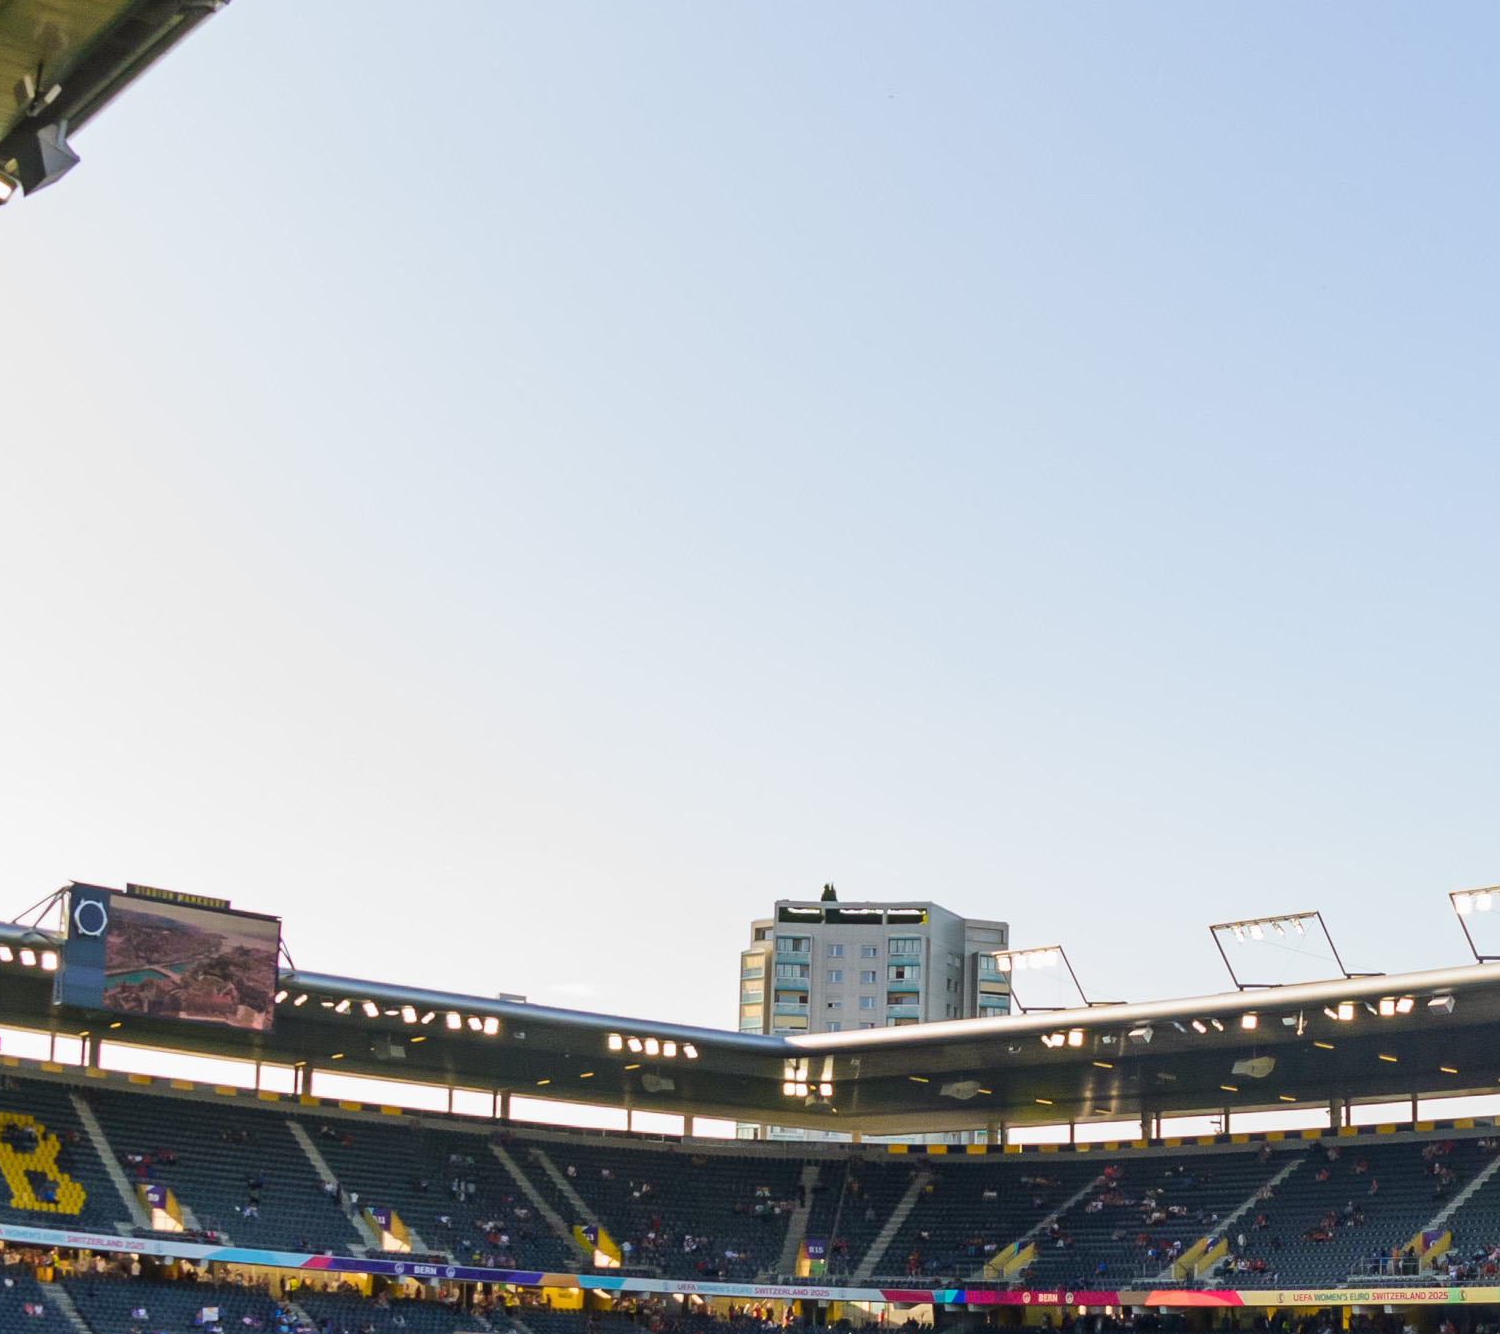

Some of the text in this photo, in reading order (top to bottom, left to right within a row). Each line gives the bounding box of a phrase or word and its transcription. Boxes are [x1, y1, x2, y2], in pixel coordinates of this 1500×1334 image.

[67, 1235, 123, 1249] SWITZERLAND
[126, 1240, 146, 1250] 2025
[414, 1265, 437, 1275] BERN
[678, 1283, 696, 1291] UEFA
[754, 1287, 809, 1297] SWITZERLAND
[810, 1289, 831, 1297] 2025
[1038, 1293, 1058, 1303] BERN
[1293, 1291, 1449, 1302] UEFA WOMEN'S EURO SWITZERLAND 2025
